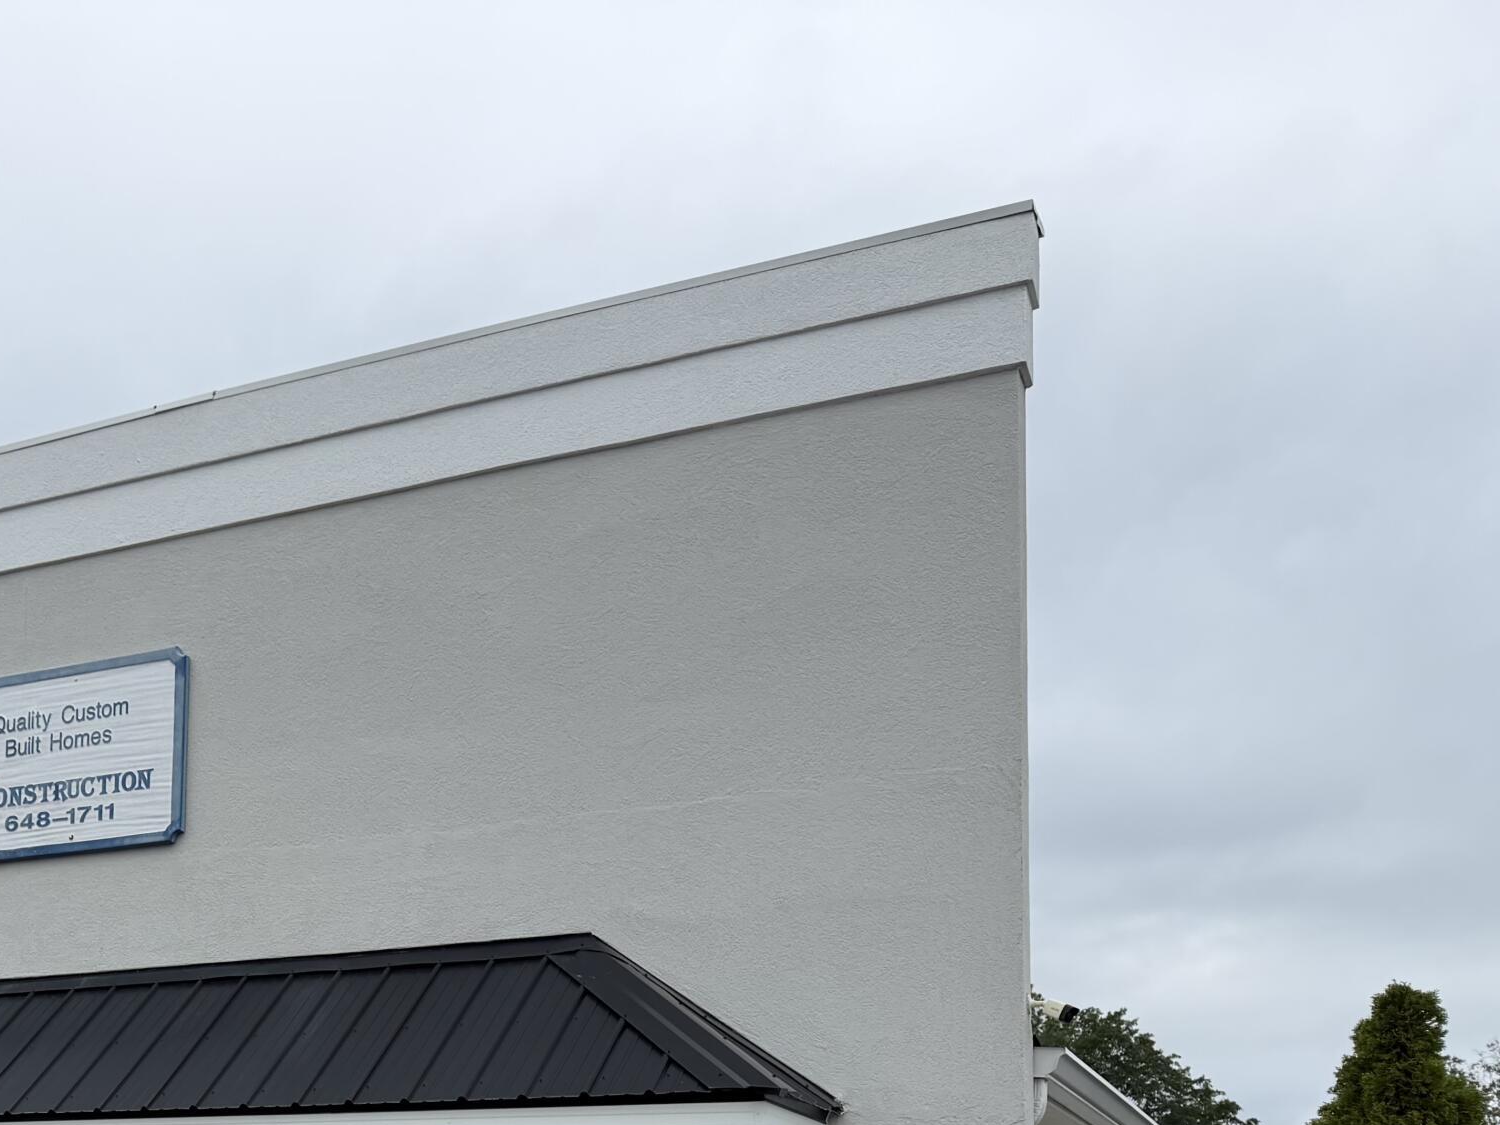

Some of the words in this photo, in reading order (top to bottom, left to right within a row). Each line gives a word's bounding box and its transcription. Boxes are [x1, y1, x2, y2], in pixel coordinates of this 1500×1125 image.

[60, 699, 130, 724] Custom
[4, 737, 42, 758] Built
[49, 727, 113, 750] Homes
[4, 803, 116, 832] 648-1711
